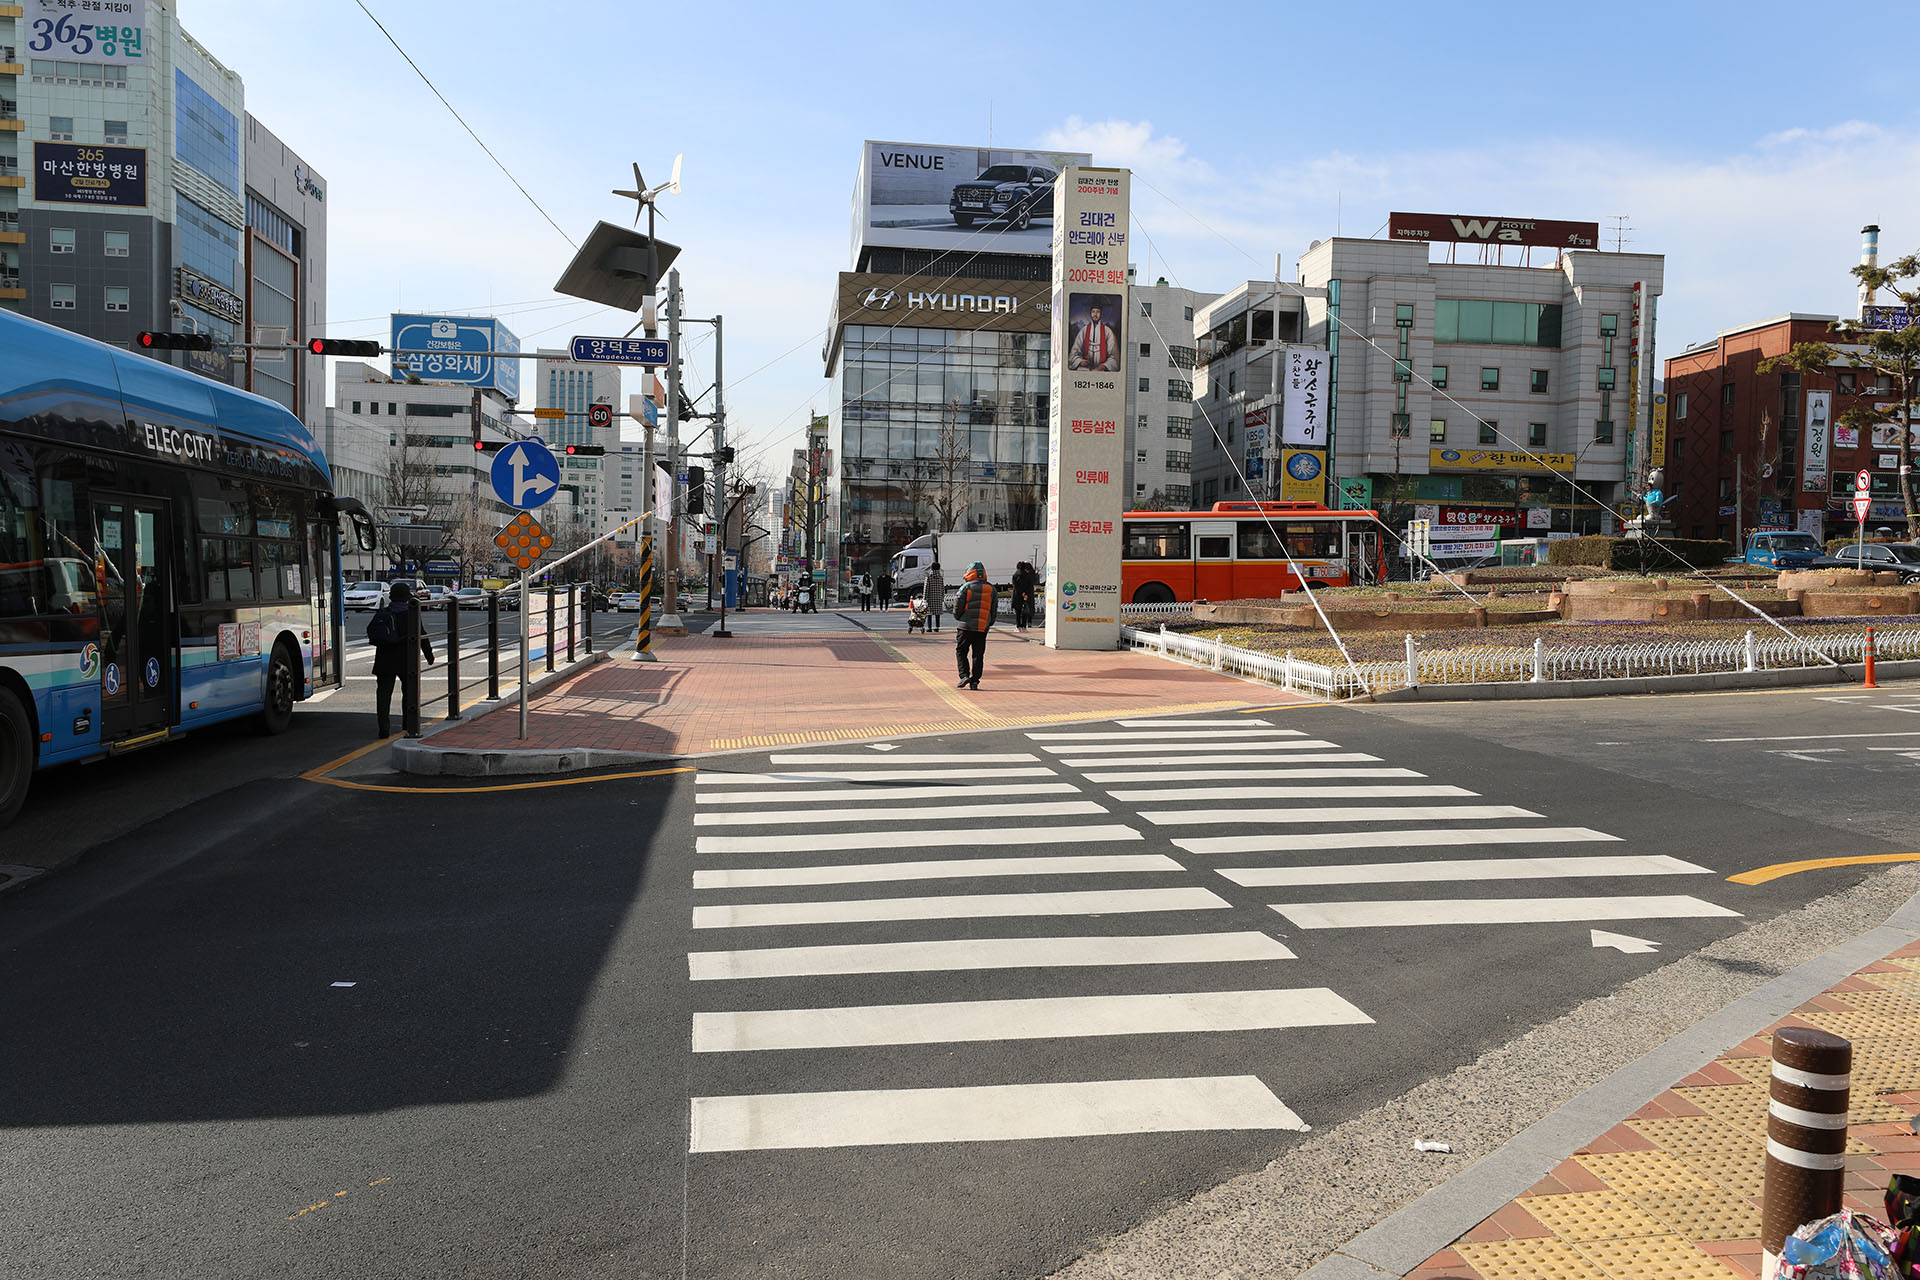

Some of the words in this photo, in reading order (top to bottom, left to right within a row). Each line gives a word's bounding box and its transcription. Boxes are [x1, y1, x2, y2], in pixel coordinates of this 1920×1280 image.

[104, 2, 132, 13] 지킴이
[29, 13, 142, 57] 365병원
[76, 148, 105, 162] 365
[880, 152, 944, 171] VENUE
[43, 160, 137, 180] 마산한방병원
[1078, 178, 1094, 186] 김대건
[1095, 178, 1106, 186] 신부
[1107, 179, 1119, 187] 탄생
[1077, 186, 1105, 195] 200주년
[1106, 187, 1119, 196] 기념
[1080, 212, 1115, 227] 김대건
[1501, 221, 1536, 230] MOTEL
[1069, 230, 1105, 246] 안드레아
[1107, 232, 1125, 247] 신부
[1085, 250, 1109, 265] 탄생
[1069, 269, 1105, 284] 200주년
[1107, 270, 1124, 284] 희년
[908, 291, 1018, 314] HYUNDAI
[426, 340, 462, 350] 건강보험은
[591, 340, 642, 354] 양덕로
[646, 347, 664, 358] 196
[408, 353, 482, 374] 삼성화재
[591, 353, 642, 361] Yangdeok-ro
[1074, 381, 1114, 390] 1821~1846
[593, 411, 608, 421] 60
[1071, 419, 1116, 435] 평등실천
[144, 423, 182, 456] ELEC
[183, 432, 212, 462] CITY
[1246, 430, 1258, 442] KBS
[1810, 428, 1824, 458] 정원
[226, 450, 245, 468] ZERO
[280, 462, 293, 478] BUS
[1489, 452, 1565, 466] 할매낙지
[1075, 470, 1110, 485] 인류애
[1760, 514, 1787, 525] 노래방
[1068, 520, 1114, 535] 문화교류
